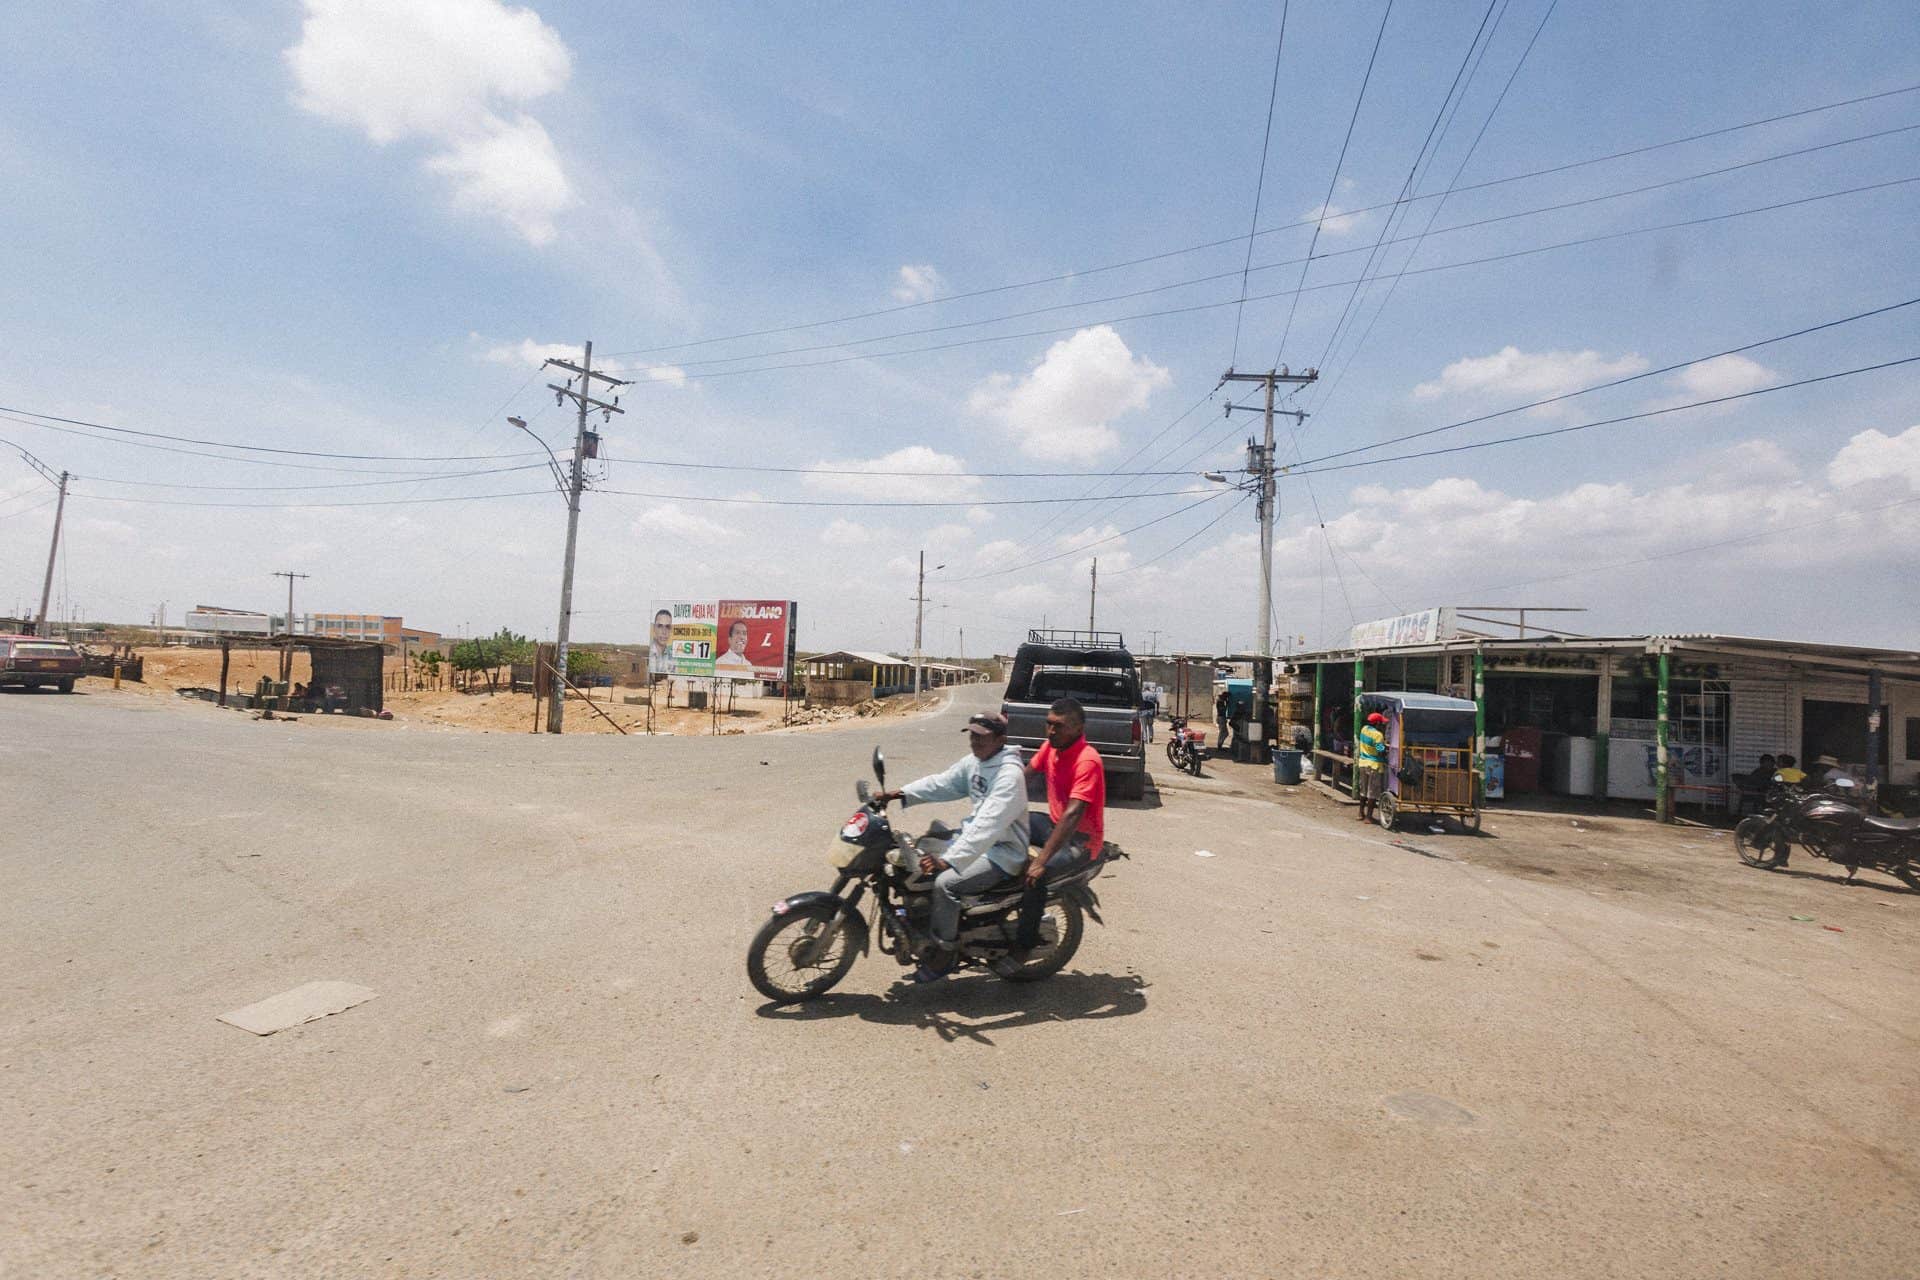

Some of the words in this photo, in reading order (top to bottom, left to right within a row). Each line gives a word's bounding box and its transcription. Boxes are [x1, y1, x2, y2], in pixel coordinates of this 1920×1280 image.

[741, 606, 782, 619] SOLANO
[676, 642, 695, 655] ASI
[698, 642, 710, 658] 17
